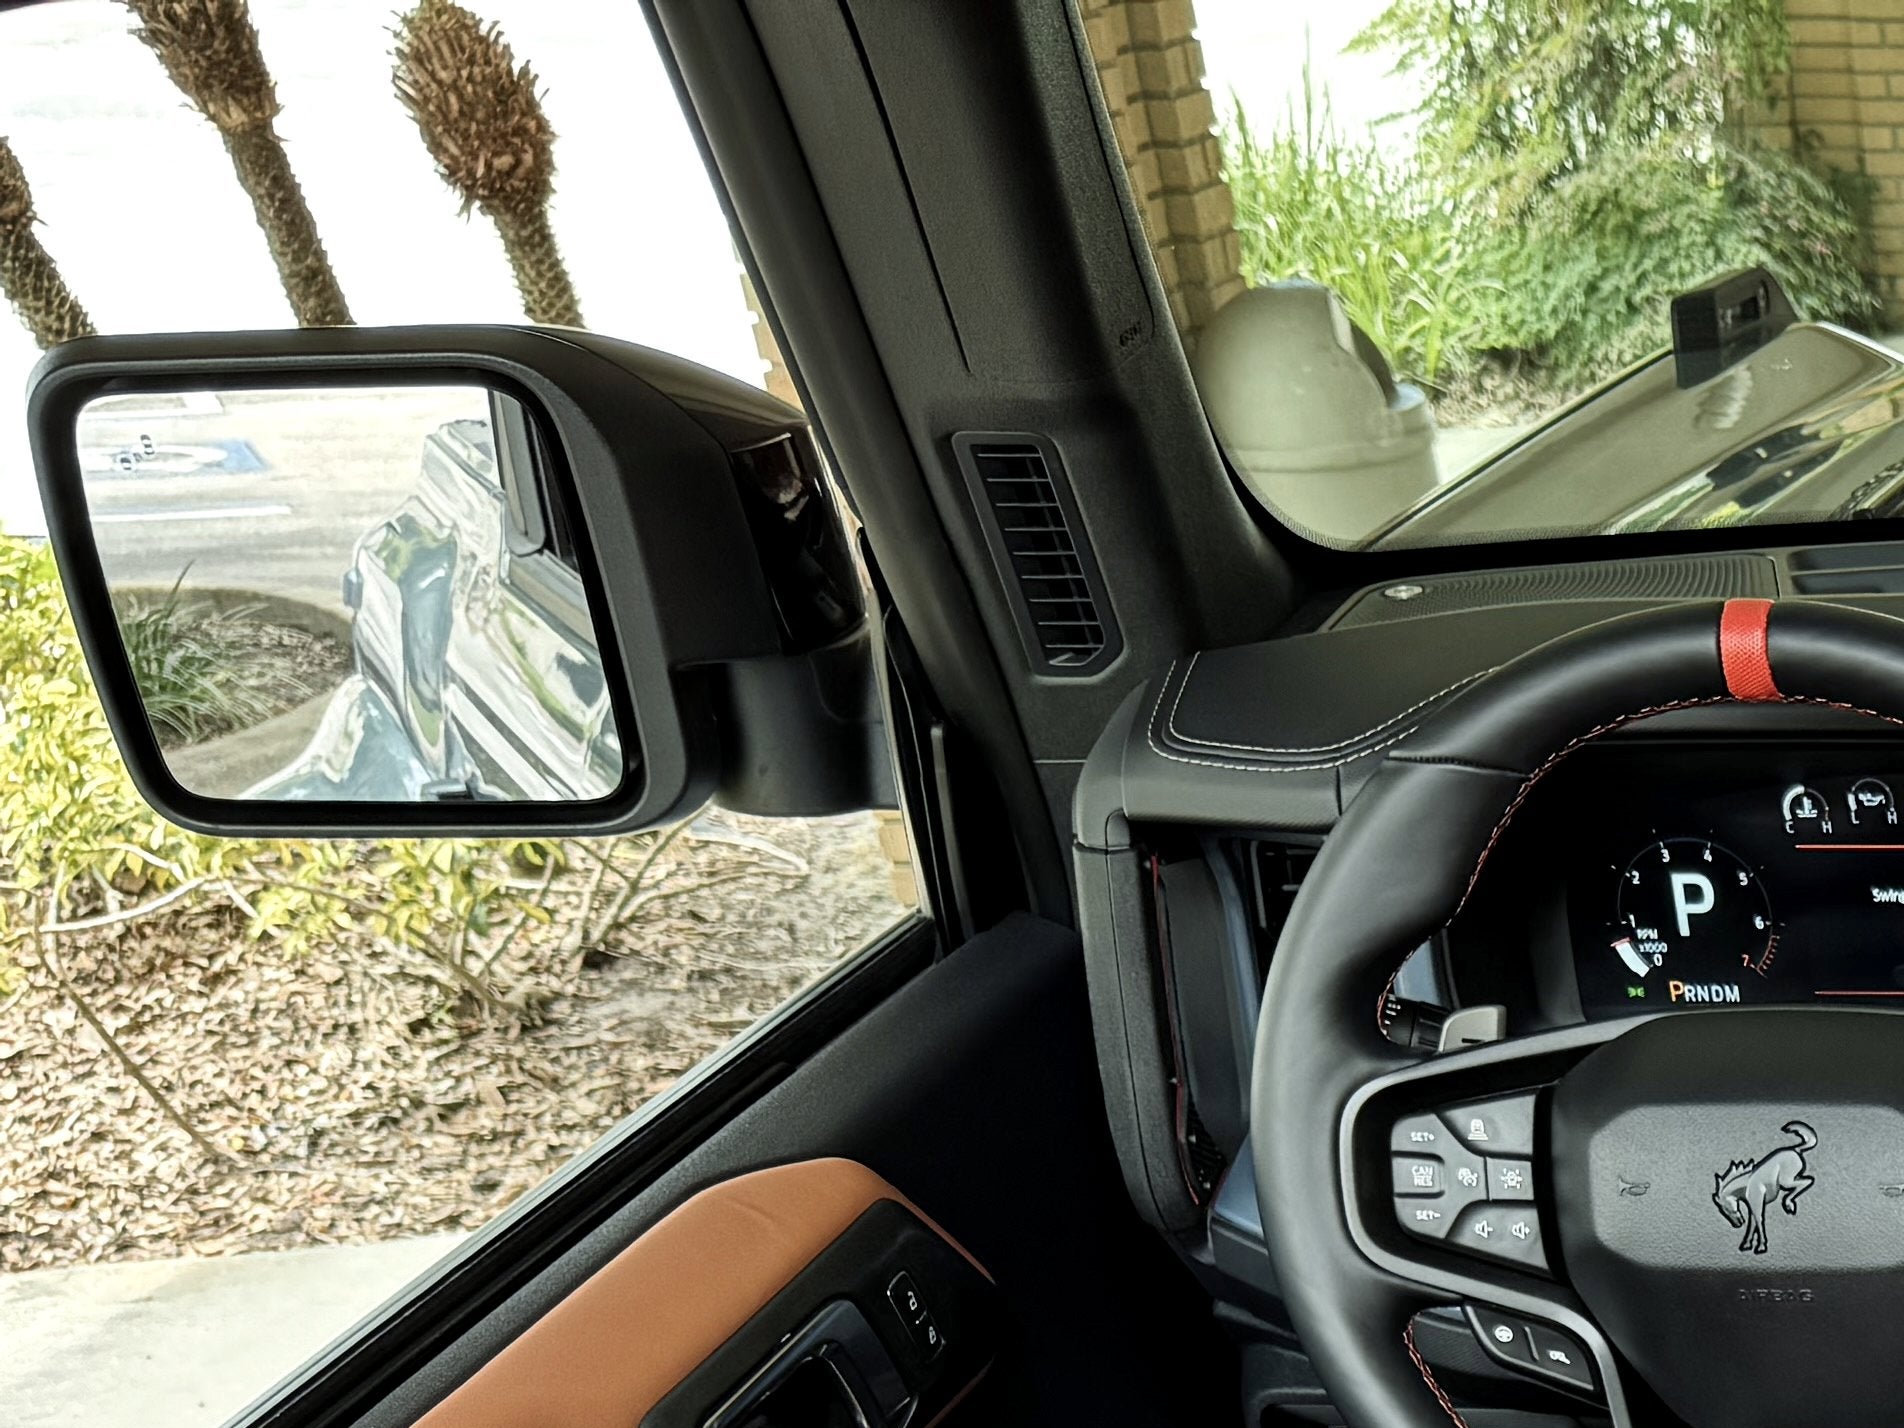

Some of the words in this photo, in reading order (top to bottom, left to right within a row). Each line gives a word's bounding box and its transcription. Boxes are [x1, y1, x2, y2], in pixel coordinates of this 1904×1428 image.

[1888, 812, 1897, 824] H
[1785, 823, 1794, 834] C
[1822, 823, 1832, 834] H
[1662, 849, 1670, 862] 3
[1703, 850, 1712, 862] 4
[1631, 870, 1640, 884] 2
[1738, 871, 1748, 885] 5
[1671, 873, 1715, 937] P
[1754, 915, 1764, 929] 6
[1653, 954, 1663, 966] 0
[1741, 954, 1749, 967] 7
